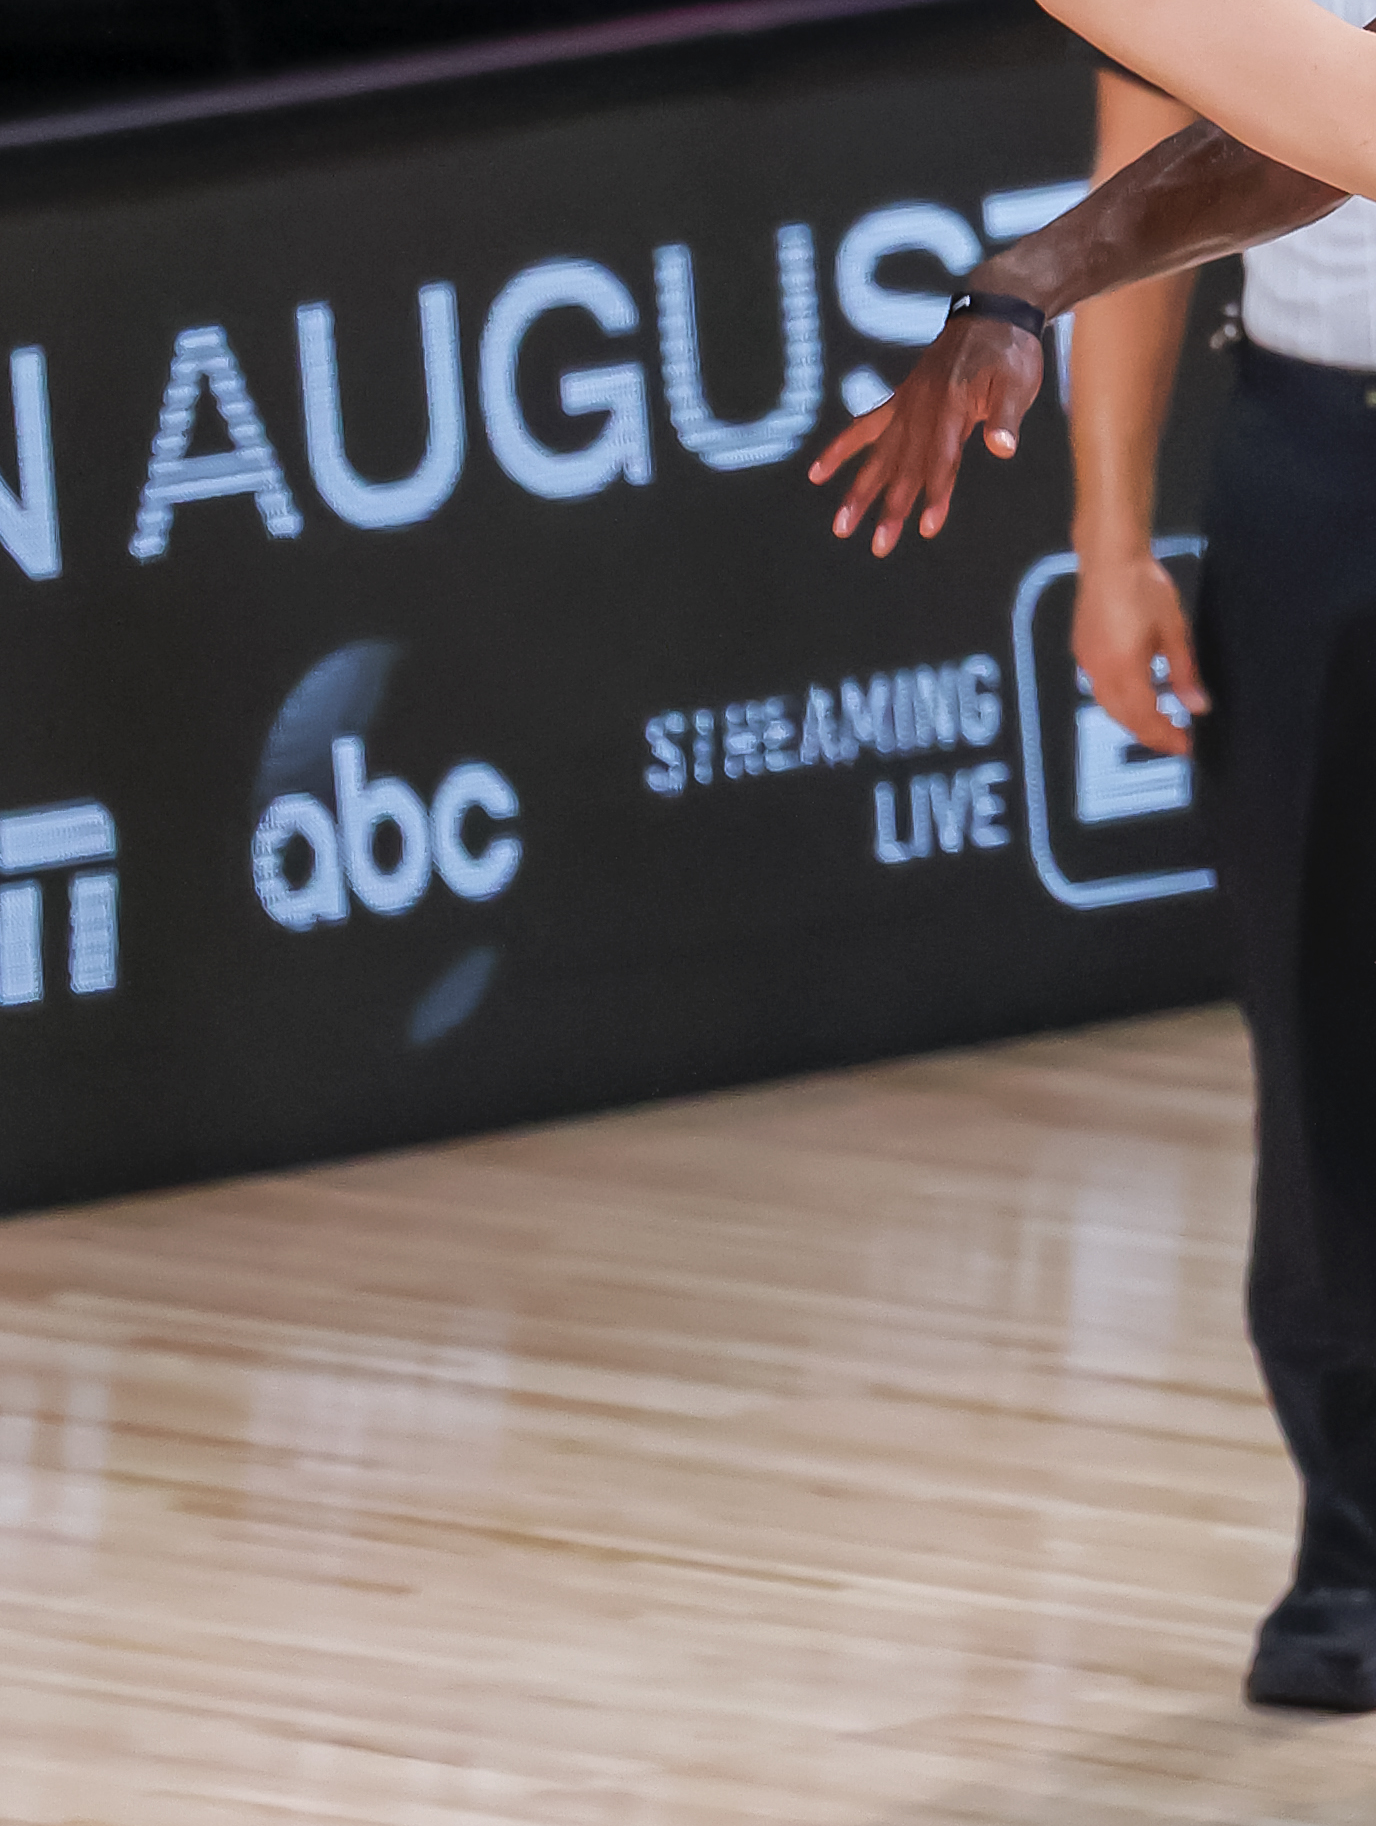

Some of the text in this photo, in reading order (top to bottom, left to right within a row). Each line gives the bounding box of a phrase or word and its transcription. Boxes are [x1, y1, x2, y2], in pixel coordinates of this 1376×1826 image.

[644, 652, 1002, 799] STREAMING
[252, 734, 522, 932] abc
[874, 761, 1010, 864] LIVE
